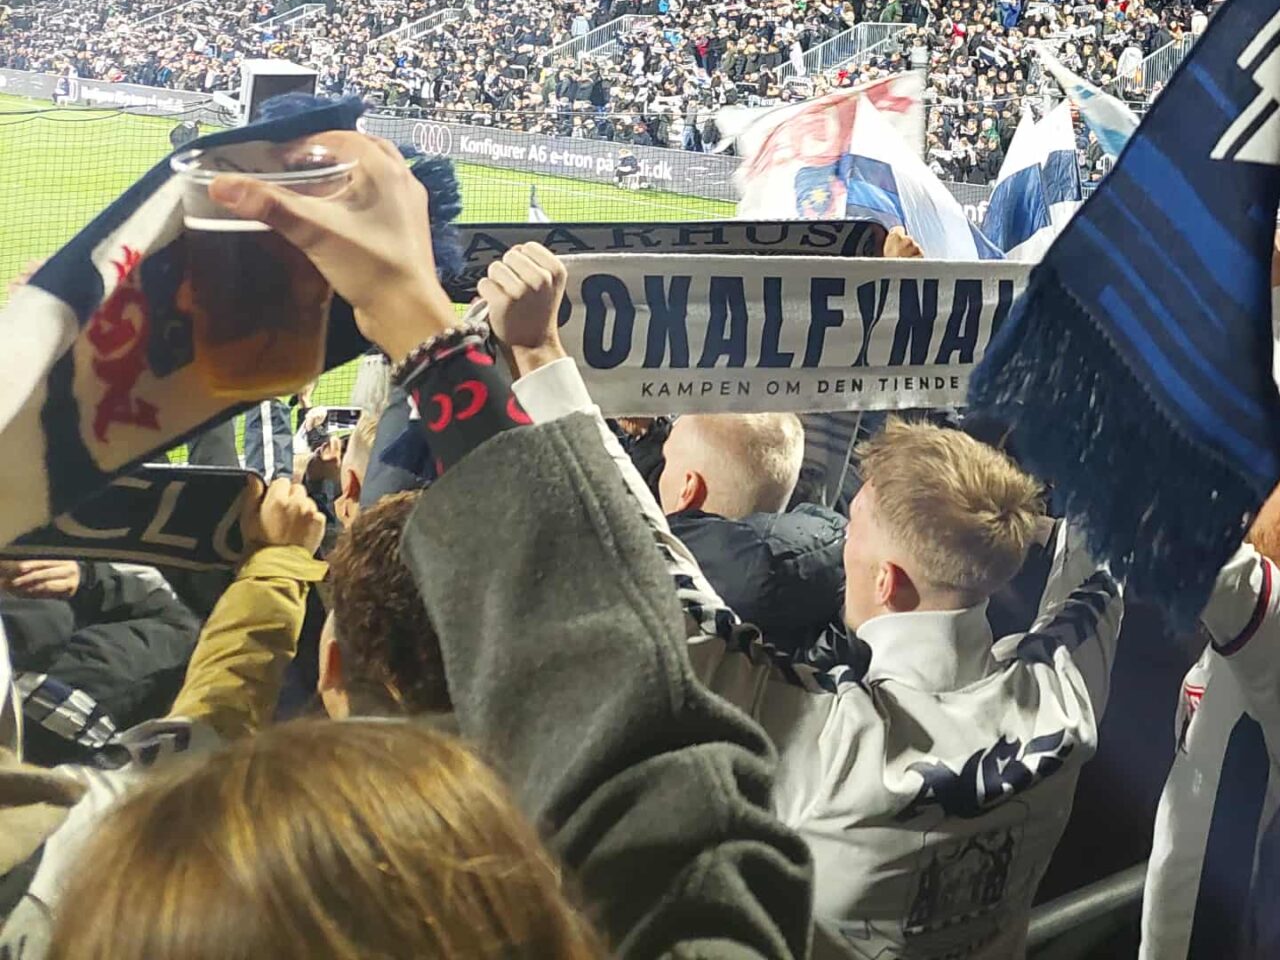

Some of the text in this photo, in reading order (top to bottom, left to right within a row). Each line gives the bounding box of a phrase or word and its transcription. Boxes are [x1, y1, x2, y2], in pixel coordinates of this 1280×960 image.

[460, 136, 526, 160] Konfigurer
[528, 144, 547, 163] A6
[550, 148, 592, 169] e-tron
[596, 153, 614, 175] på
[463, 225, 844, 261] AARHUS
[641, 376, 961, 397] KAMPEN OM DEN TIENDE
